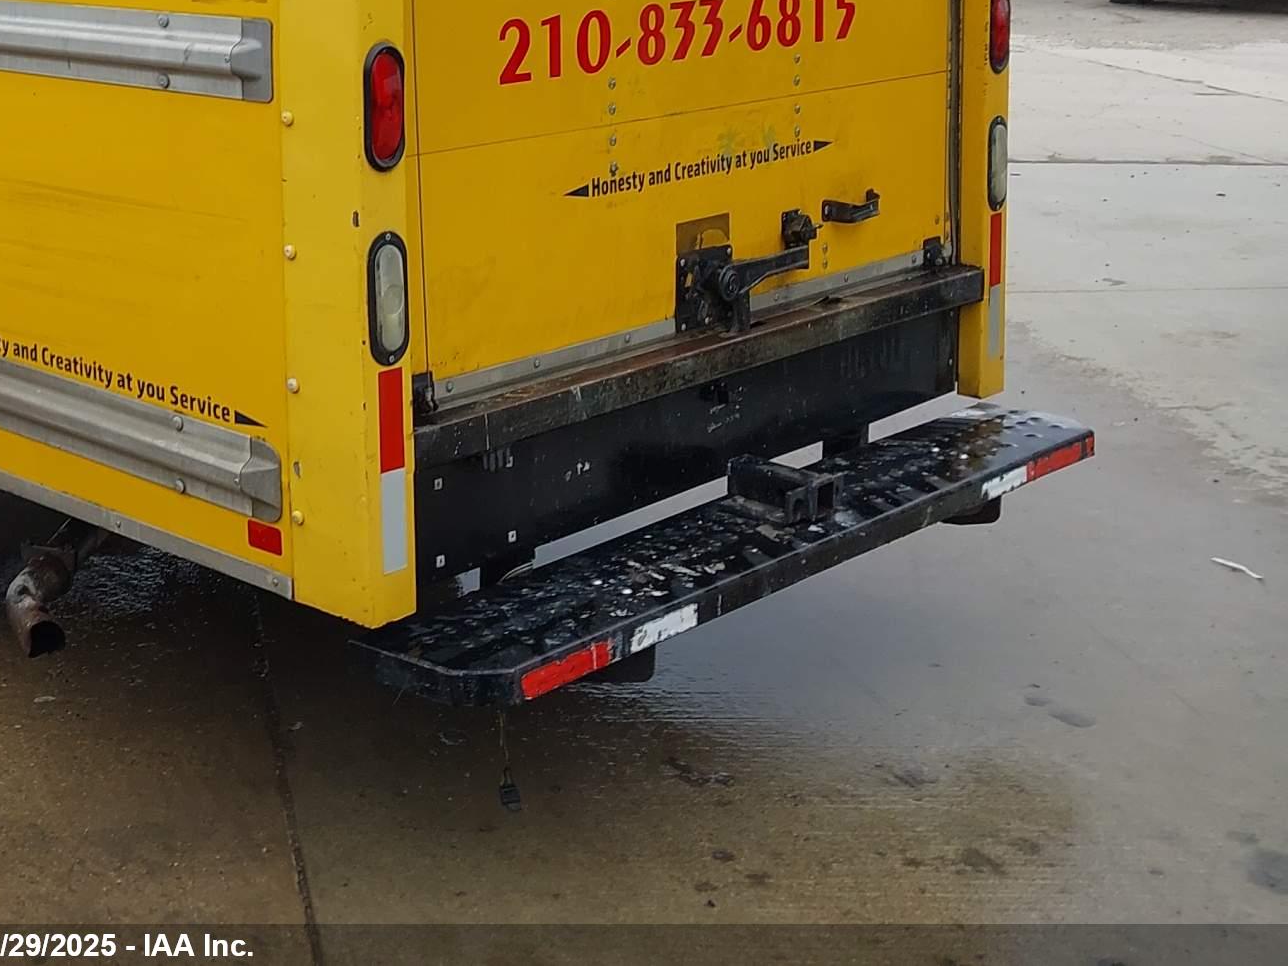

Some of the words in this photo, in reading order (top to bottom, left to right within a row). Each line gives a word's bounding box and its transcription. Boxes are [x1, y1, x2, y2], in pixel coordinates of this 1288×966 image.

[591, 172, 646, 198] Honesty
[648, 163, 671, 186] and
[674, 153, 733, 180] Creativity
[735, 151, 748, 167] at
[750, 149, 770, 170] you
[772, 139, 812, 162] Service
[13, 340, 38, 363] and
[41, 347, 114, 386] Creativity
[117, 371, 133, 393] at
[137, 379, 166, 407] you
[169, 384, 231, 423] Service
